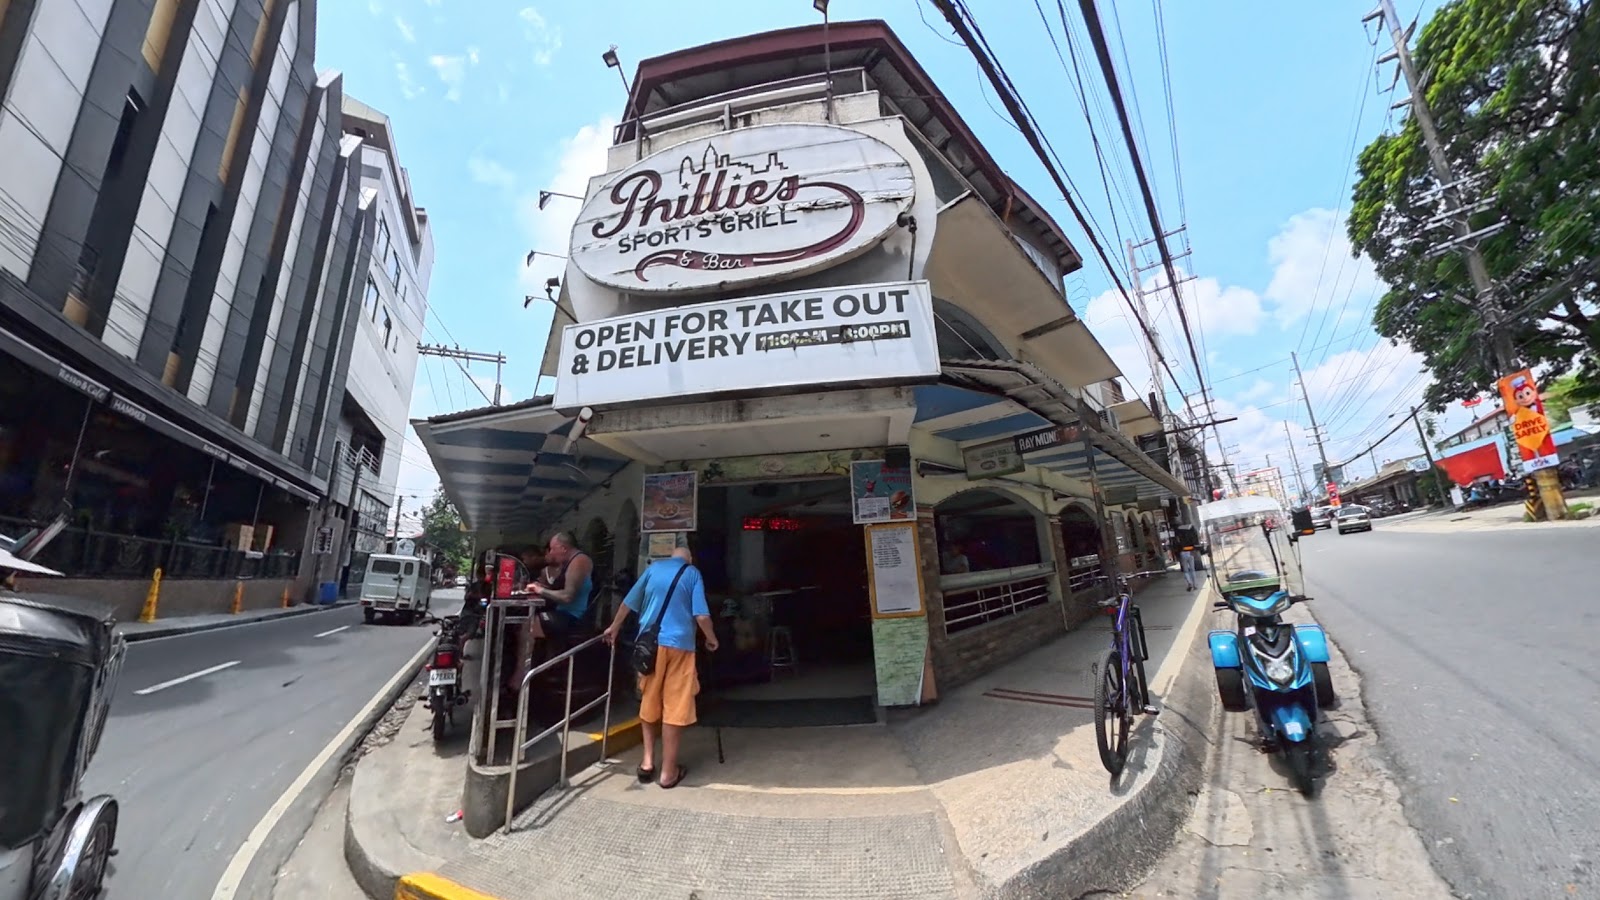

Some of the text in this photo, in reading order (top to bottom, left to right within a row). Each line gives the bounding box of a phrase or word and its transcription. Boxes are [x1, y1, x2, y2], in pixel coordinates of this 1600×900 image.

[592, 169, 799, 238] Phillies
[618, 205, 797, 253] SPORTS GRILL
[679, 250, 746, 269] & Bar
[575, 290, 909, 349] OPEN FOR TAKE OUT
[571, 353, 589, 375] &
[597, 332, 751, 372] DELIVERY
[1515, 417, 1542, 431] DRIVE
[1515, 424, 1547, 439] SAFELY
